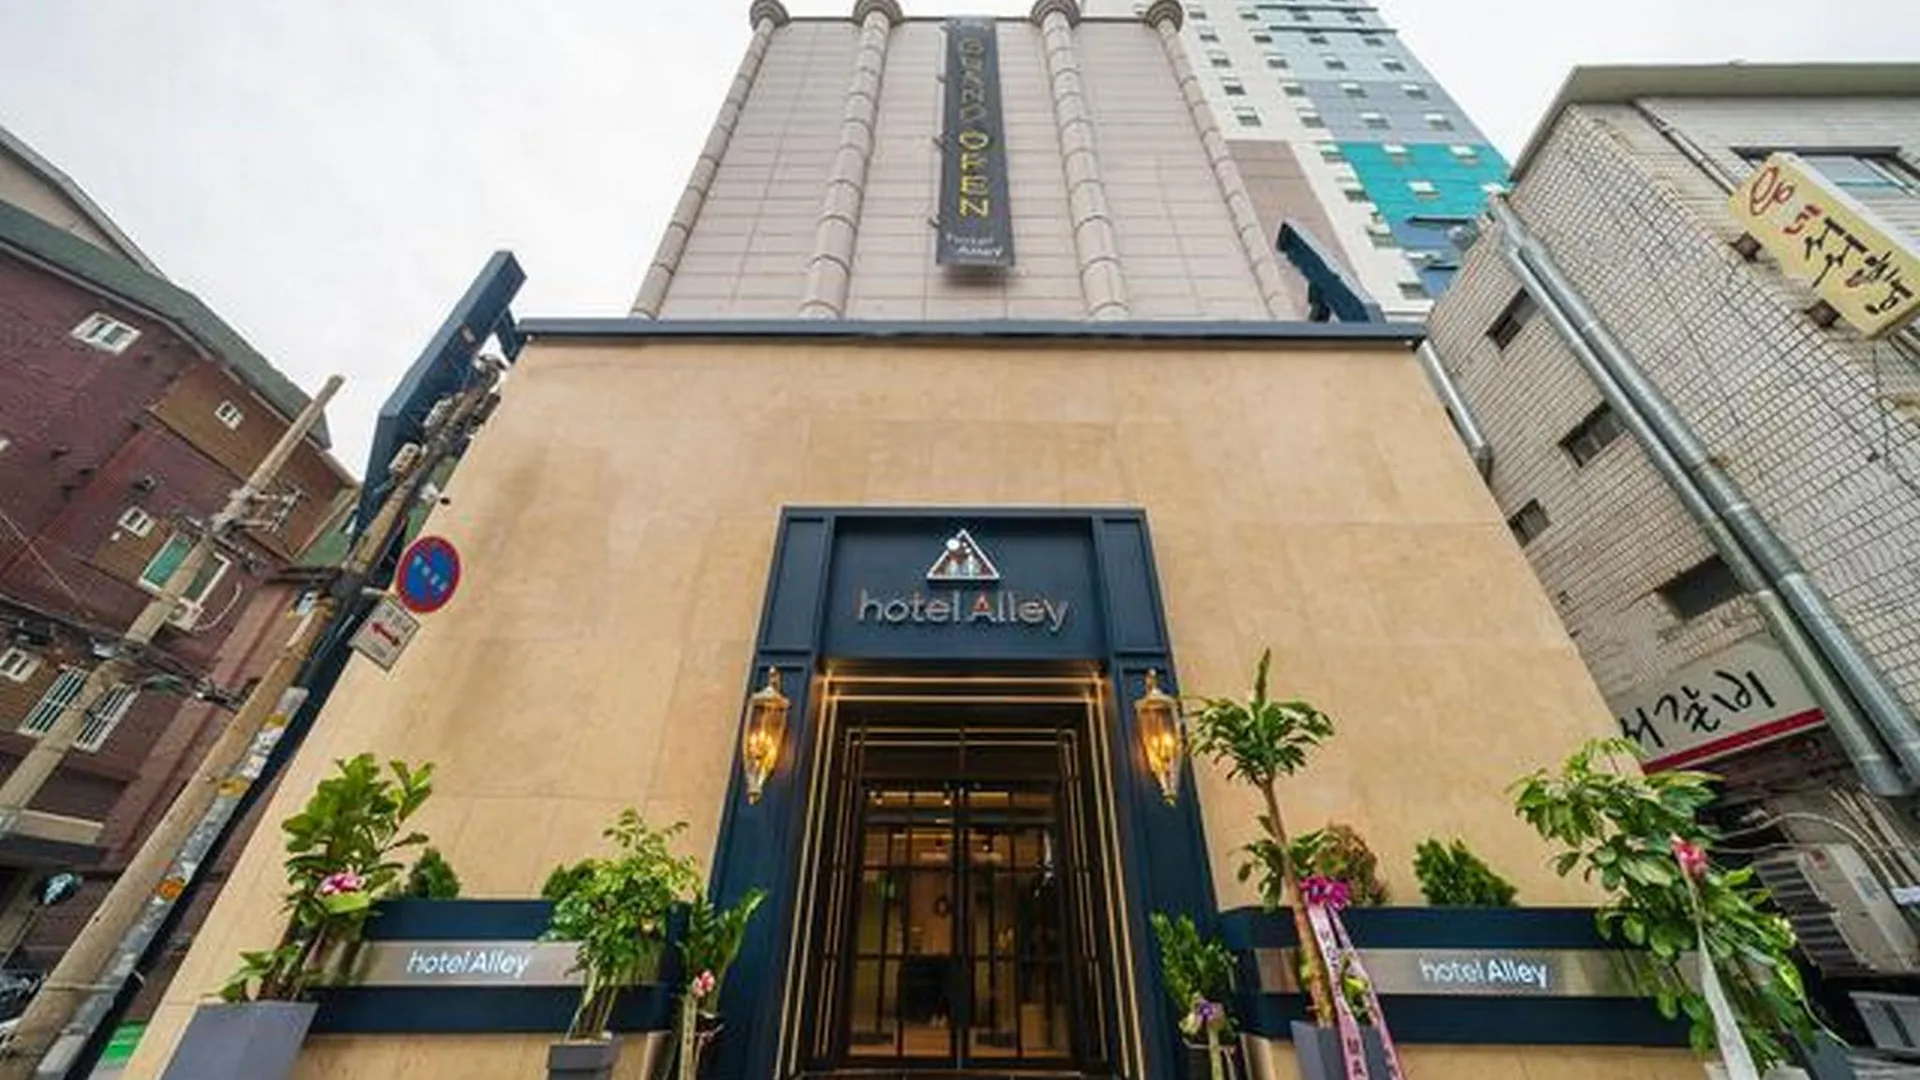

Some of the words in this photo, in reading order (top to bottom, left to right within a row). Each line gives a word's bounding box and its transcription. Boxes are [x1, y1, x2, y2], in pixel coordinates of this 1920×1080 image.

[958, 129, 989, 217] OPEN
[857, 588, 961, 622] hotel
[966, 589, 1070, 632] Alley
[407, 949, 470, 974] hotel
[468, 949, 530, 979] Alley
[1418, 956, 1485, 982] hotel
[1487, 958, 1548, 988] Alley
